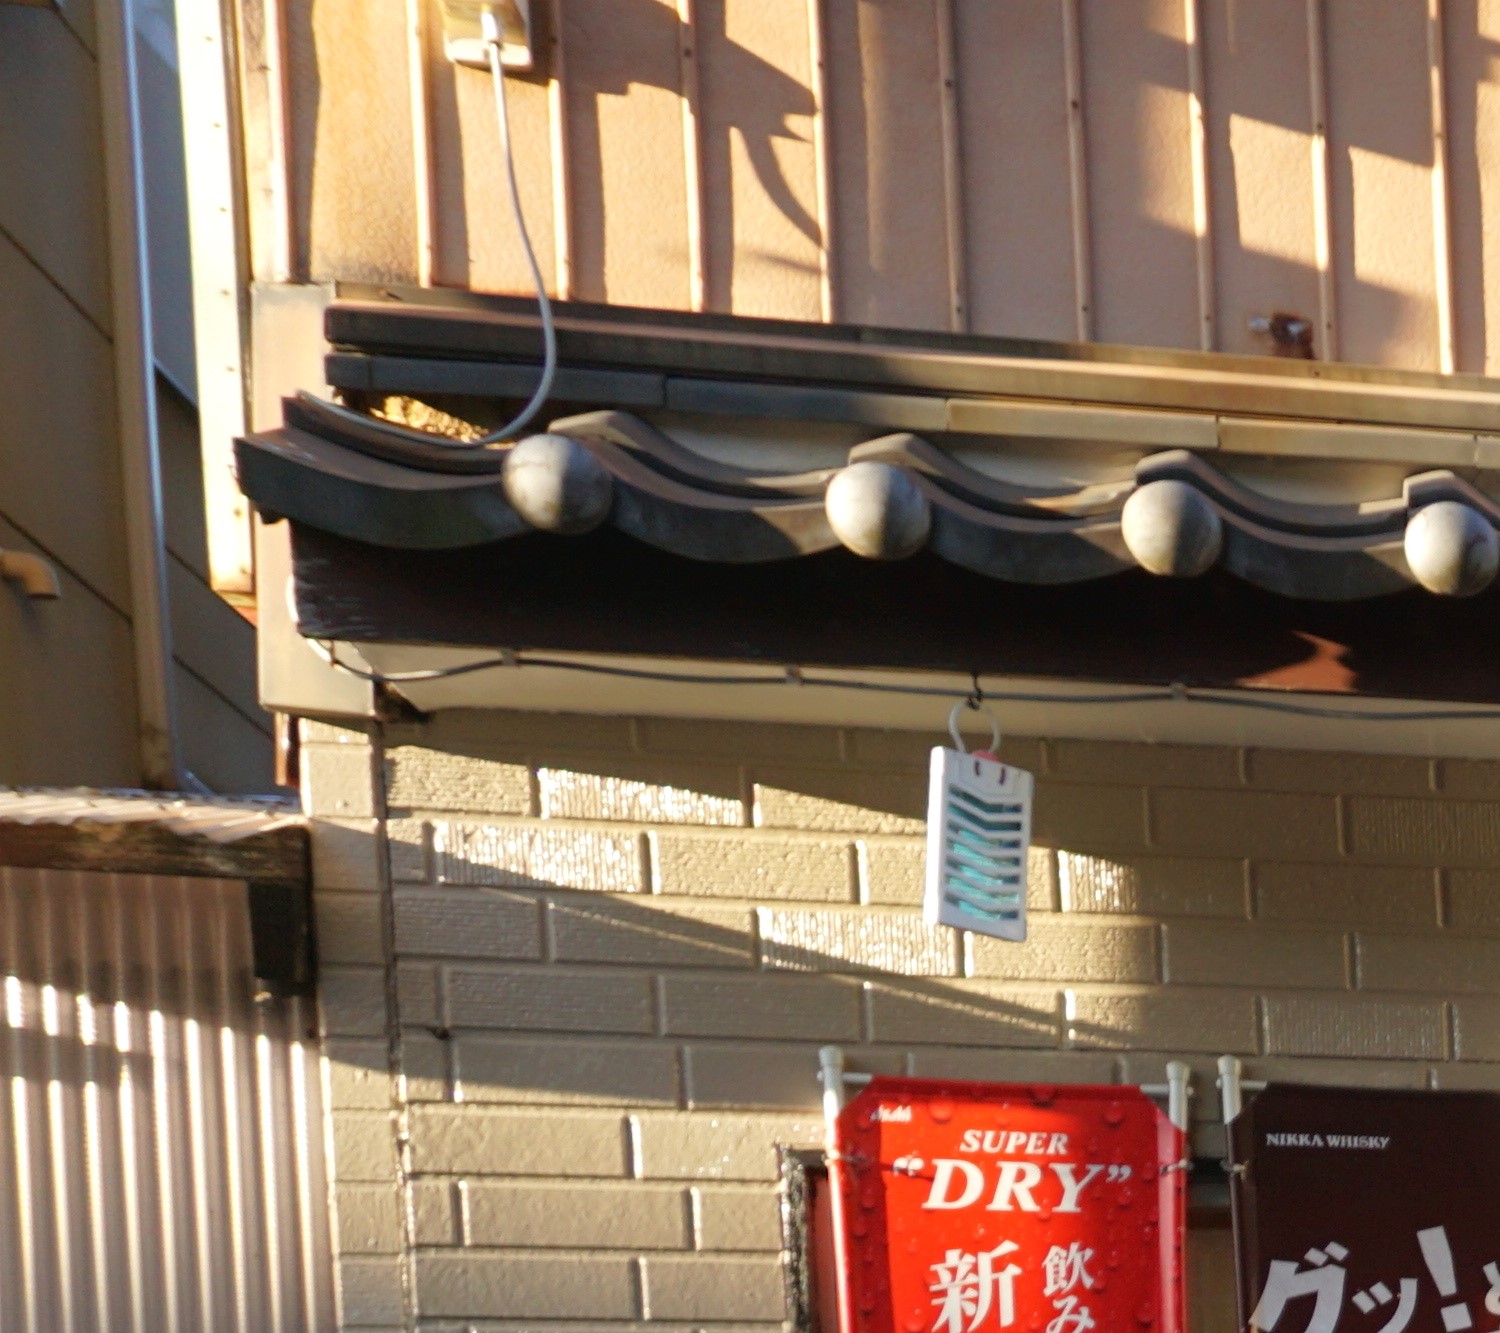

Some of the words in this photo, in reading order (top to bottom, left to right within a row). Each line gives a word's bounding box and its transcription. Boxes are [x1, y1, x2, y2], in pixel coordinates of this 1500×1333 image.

[959, 1129, 1069, 1155] SUPER
[1266, 1133, 1324, 1148] NIKKA
[1326, 1135, 1391, 1149] WHISKY
